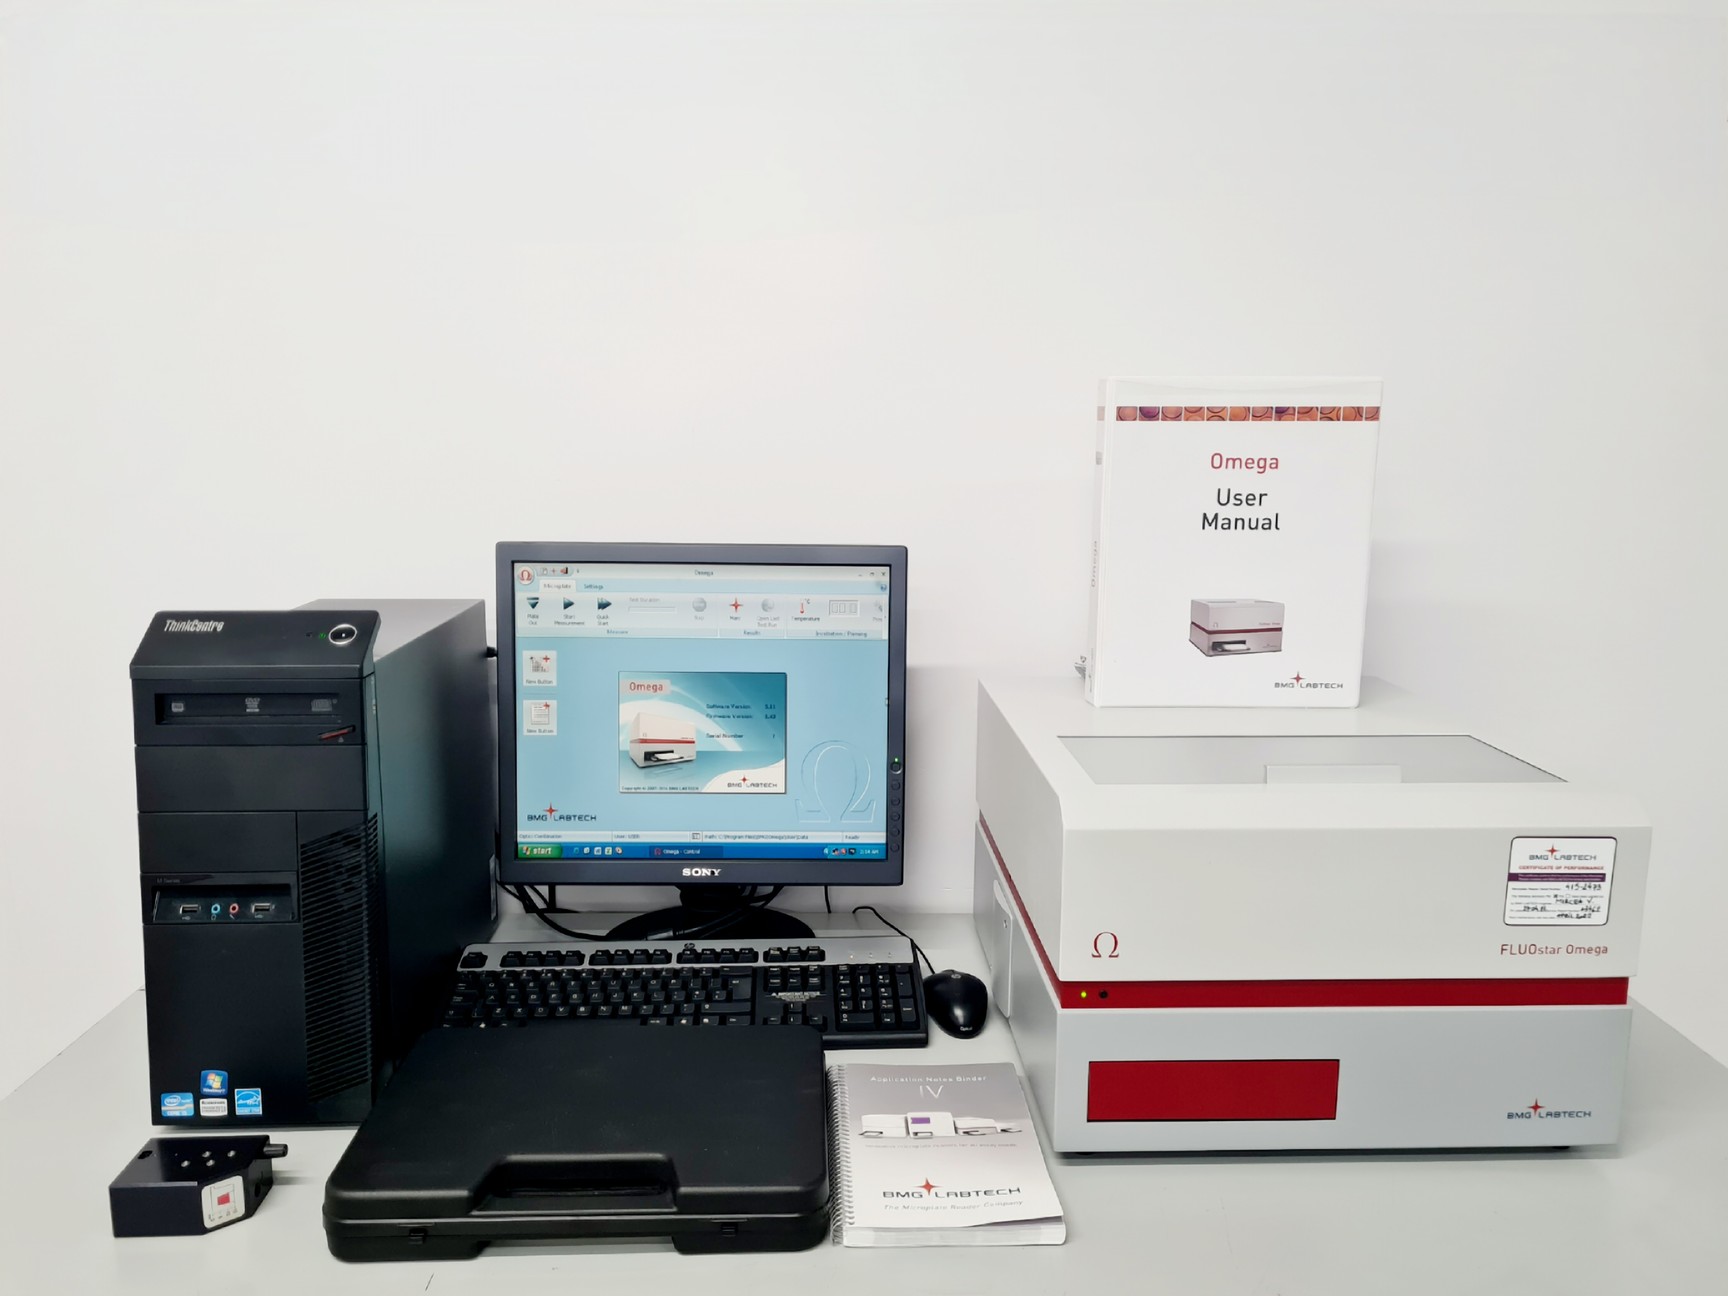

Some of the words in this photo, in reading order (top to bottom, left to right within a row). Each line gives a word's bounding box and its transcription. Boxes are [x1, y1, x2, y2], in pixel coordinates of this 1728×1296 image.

[1210, 452, 1280, 474] Omega
[1217, 488, 1268, 506] User
[1201, 512, 1281, 531] Manual
[163, 619, 225, 632] ThinkCentre
[629, 681, 664, 693] Omega
[527, 814, 548, 822] BMG
[553, 814, 597, 822] LABTECH
[532, 846, 552, 855] start
[682, 868, 722, 877] SONY
[1500, 943, 1562, 956] FLUOstar
[1565, 944, 1608, 957] Omega
[870, 1076, 923, 1084] Application
[918, 1084, 944, 1099] IV
[1507, 1111, 1532, 1120] BMG
[1538, 1110, 1592, 1119] LABTECH
[882, 1190, 924, 1199] BMG
[934, 1187, 1021, 1198] LABTECH
[983, 1200, 1024, 1209] Company
